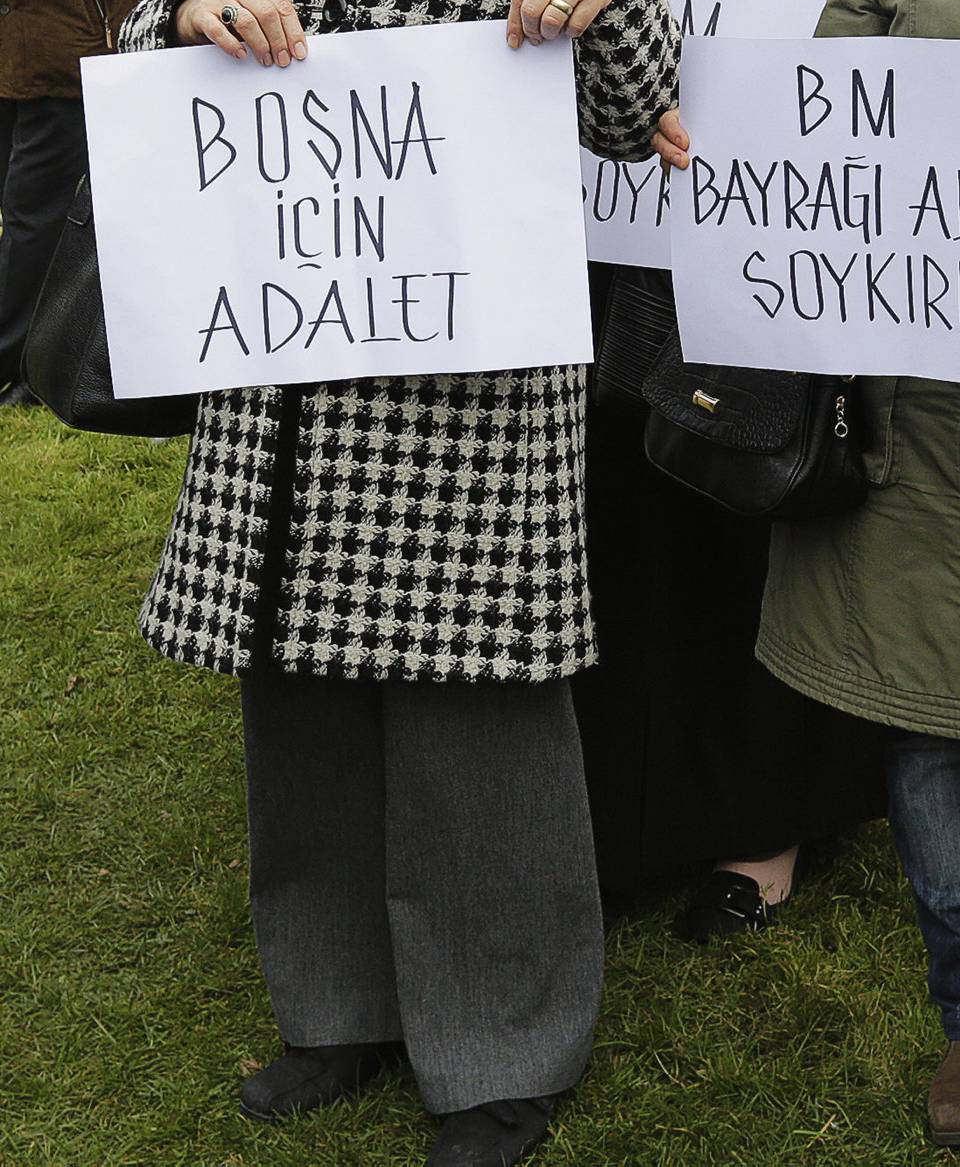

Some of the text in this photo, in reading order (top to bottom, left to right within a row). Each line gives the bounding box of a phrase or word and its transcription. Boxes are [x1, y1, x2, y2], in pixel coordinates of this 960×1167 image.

[192, 81, 447, 193] BOSNA
[691, 155, 883, 245] BAYRAĞI
[198, 271, 471, 364] ADALET
